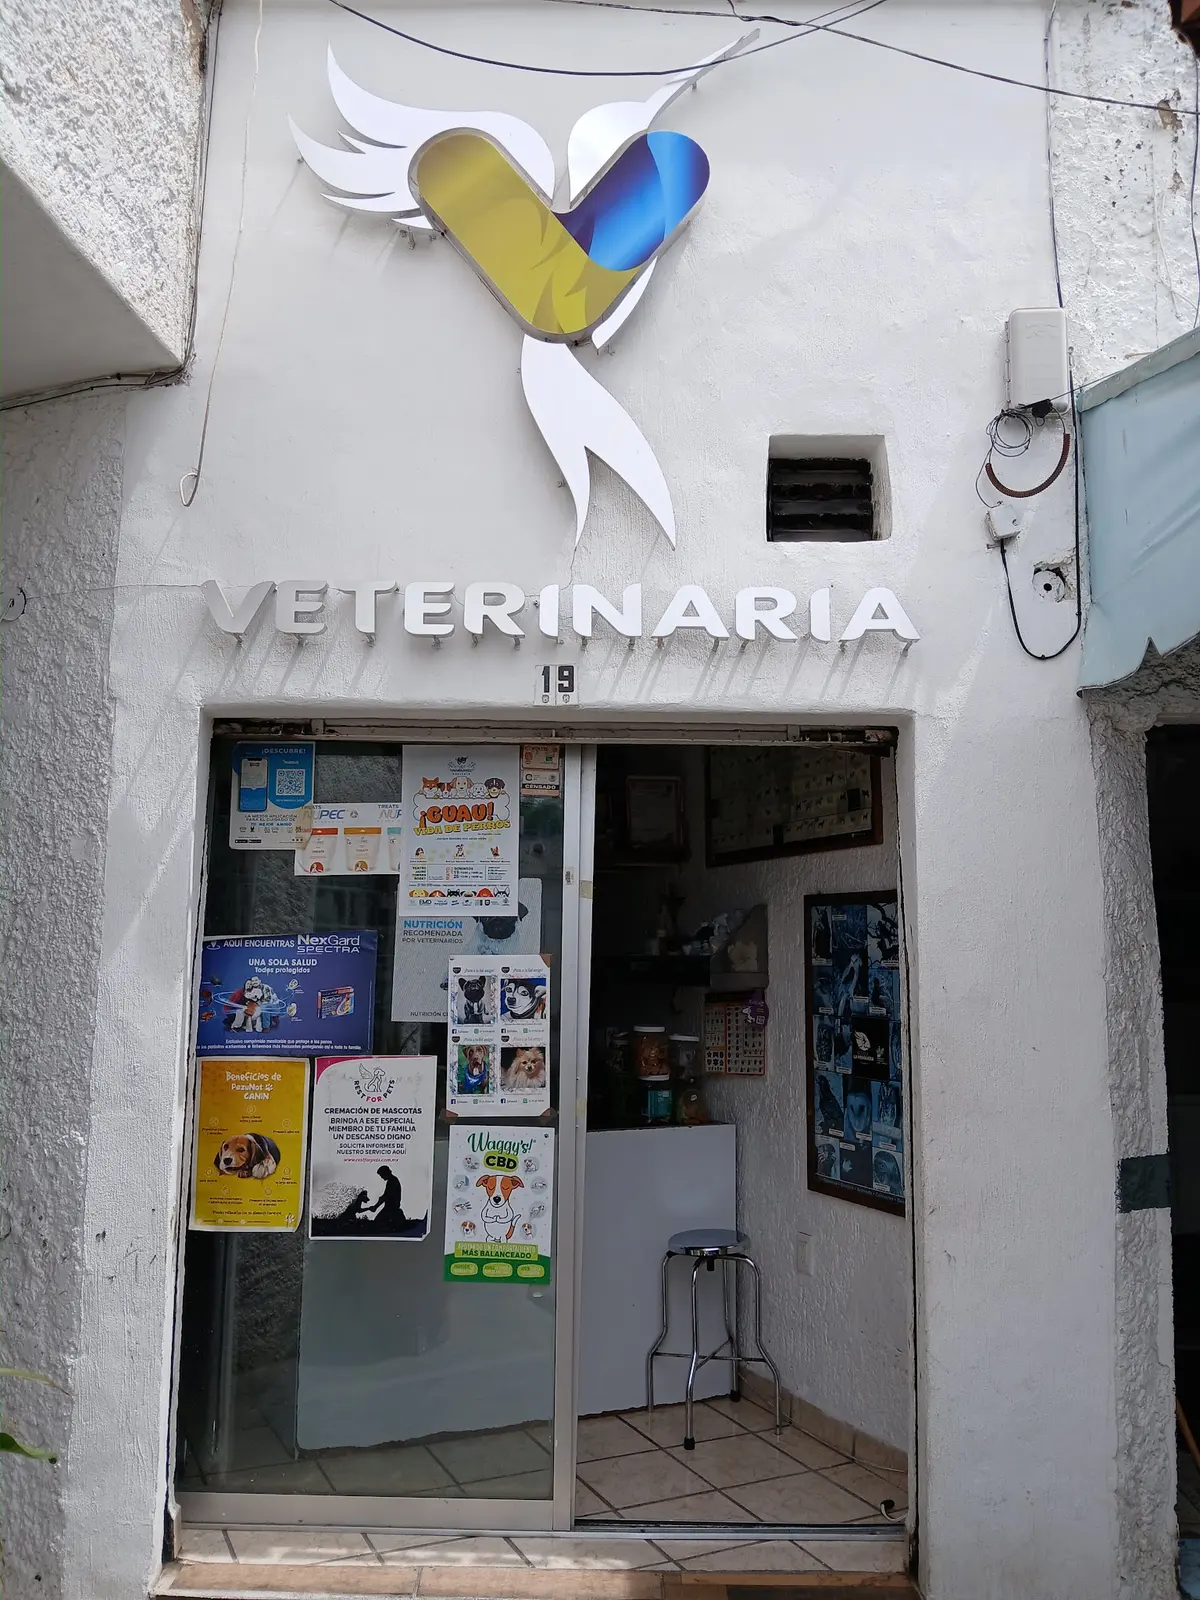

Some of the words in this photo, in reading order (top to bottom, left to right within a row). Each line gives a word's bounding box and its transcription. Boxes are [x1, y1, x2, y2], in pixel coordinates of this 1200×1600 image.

[202, 579, 919, 642] VETERINARIA
[541, 665, 574, 693] 19
[419, 802, 494, 828] ¡GUAU!
[414, 826, 443, 837] VIDA
[445, 824, 461, 833] DE
[463, 820, 511, 832] PERROS
[404, 919, 463, 929] NUTRICIÓN
[223, 938, 243, 948] AQUÍ
[245, 939, 295, 948] ENCUENTRAS
[297, 935, 360, 946] NexGard
[275, 966, 311, 975] protegidos
[226, 1072, 269, 1082] Beneficios
[271, 1072, 282, 1081] de
[354, 1080, 366, 1099] REST
[383, 1079, 396, 1099] PETS
[324, 1106, 369, 1114] CREMACIÓN
[486, 1156, 517, 1170] CBD
[480, 1251, 532, 1259] BALANCEADO
